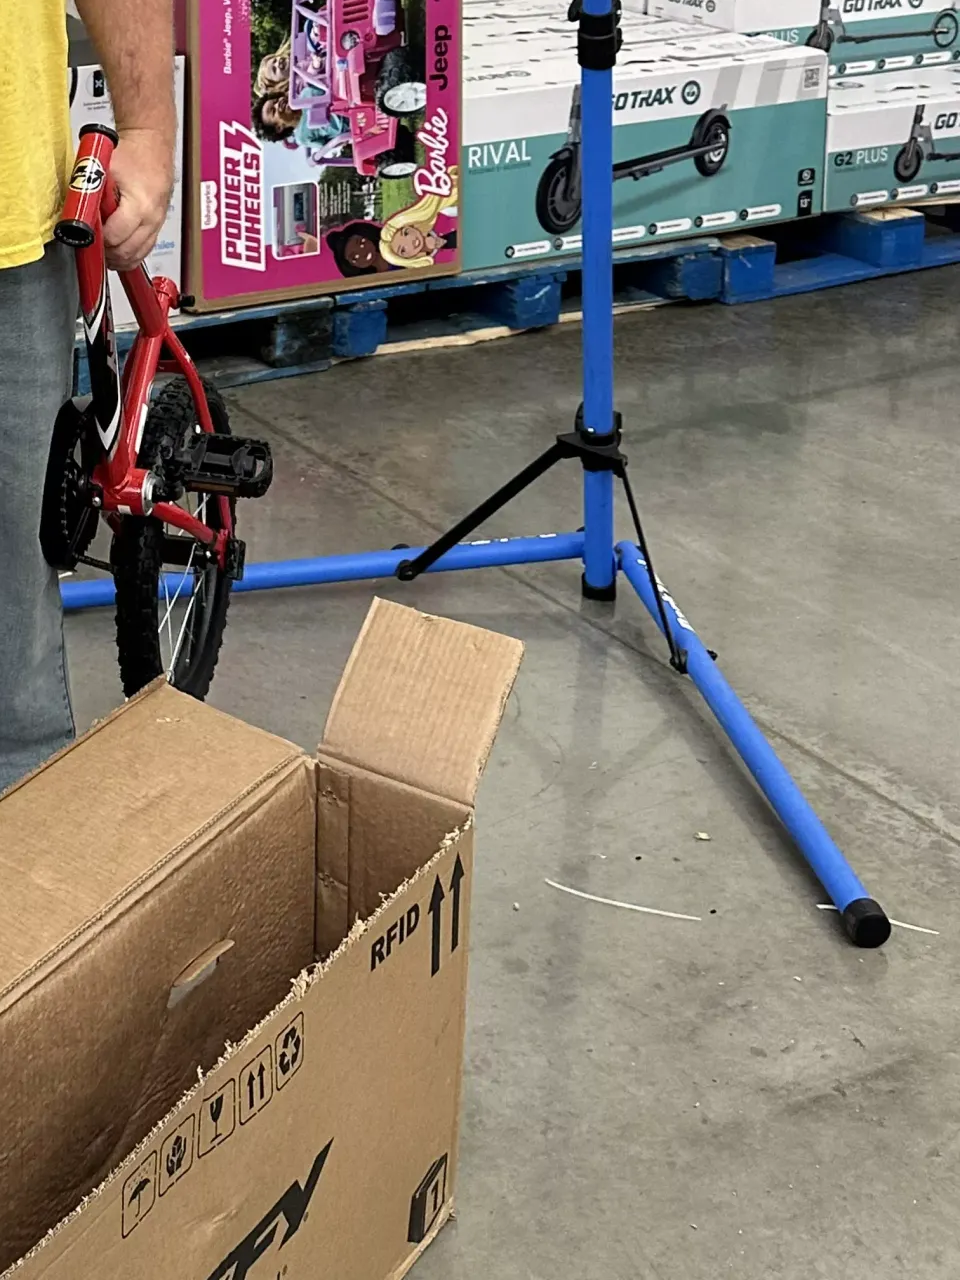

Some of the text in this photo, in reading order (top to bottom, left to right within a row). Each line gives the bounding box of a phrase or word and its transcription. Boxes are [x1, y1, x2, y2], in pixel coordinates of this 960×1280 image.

[428, 24, 452, 92] Jeep
[414, 107, 453, 197] Barbie
[467, 139, 532, 169] RIVAL
[834, 147, 889, 167] G2 PLUS
[224, 155, 242, 261] POWER
[243, 152, 262, 264] WHEELS
[370, 902, 420, 972] RFID
